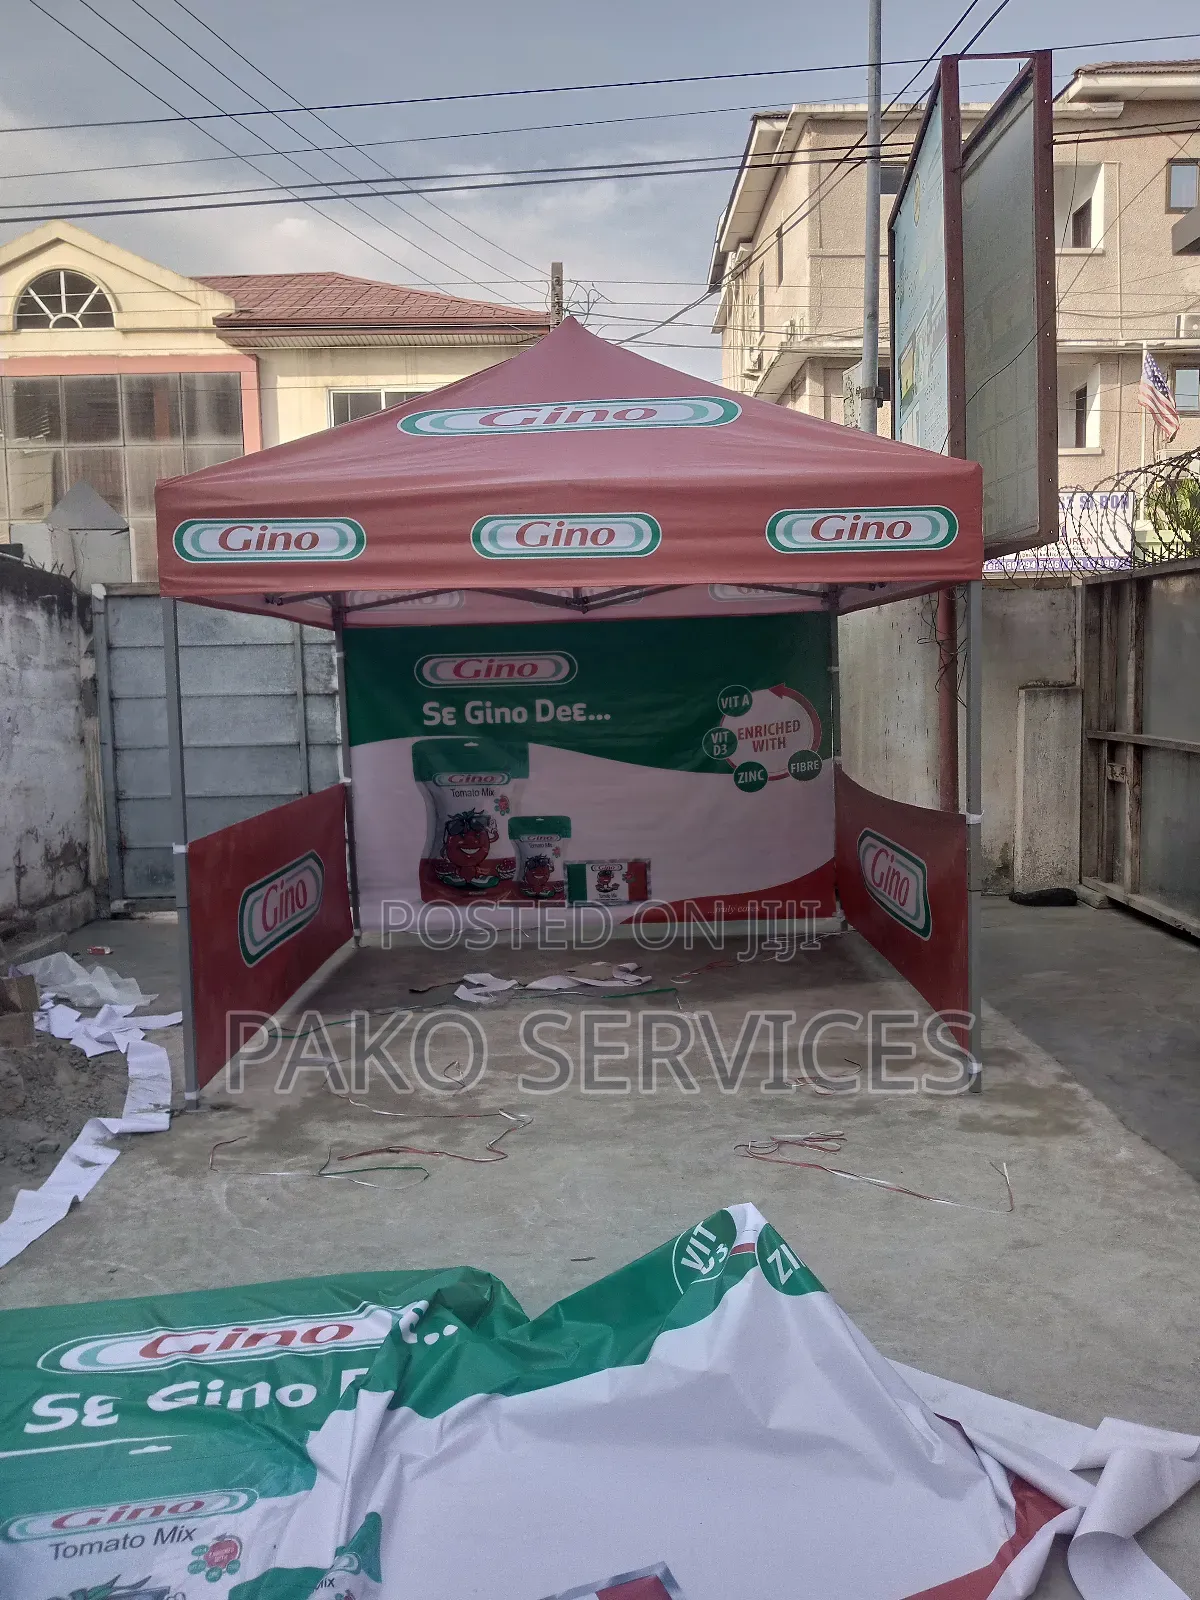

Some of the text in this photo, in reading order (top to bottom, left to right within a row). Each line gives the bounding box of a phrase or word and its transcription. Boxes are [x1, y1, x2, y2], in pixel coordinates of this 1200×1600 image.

[478, 407, 657, 427] Gino
[218, 525, 319, 551] Gino
[516, 521, 616, 548] Gino
[811, 514, 912, 541] Gino
[453, 658, 539, 679] Gino
[464, 700, 529, 724] Gino
[721, 694, 750, 709] VIT A
[711, 731, 729, 744] VIT
[737, 719, 801, 741] ENRICHED
[713, 744, 728, 756] D3
[752, 736, 787, 753] WITH
[447, 774, 496, 784] Gino
[737, 769, 765, 784] ZINC
[790, 760, 820, 774] FIBRE
[450, 787, 495, 798] Tomato Mix
[871, 848, 910, 907] Gino
[262, 879, 308, 933] Gino
[681, 1221, 717, 1271] VIT
[766, 1243, 806, 1285] ZI
[139, 1324, 354, 1358] Gino
[146, 1379, 317, 1412] Gino
[51, 1500, 206, 1530] Gino
[50, 1525, 198, 1561] Tomato Mix
